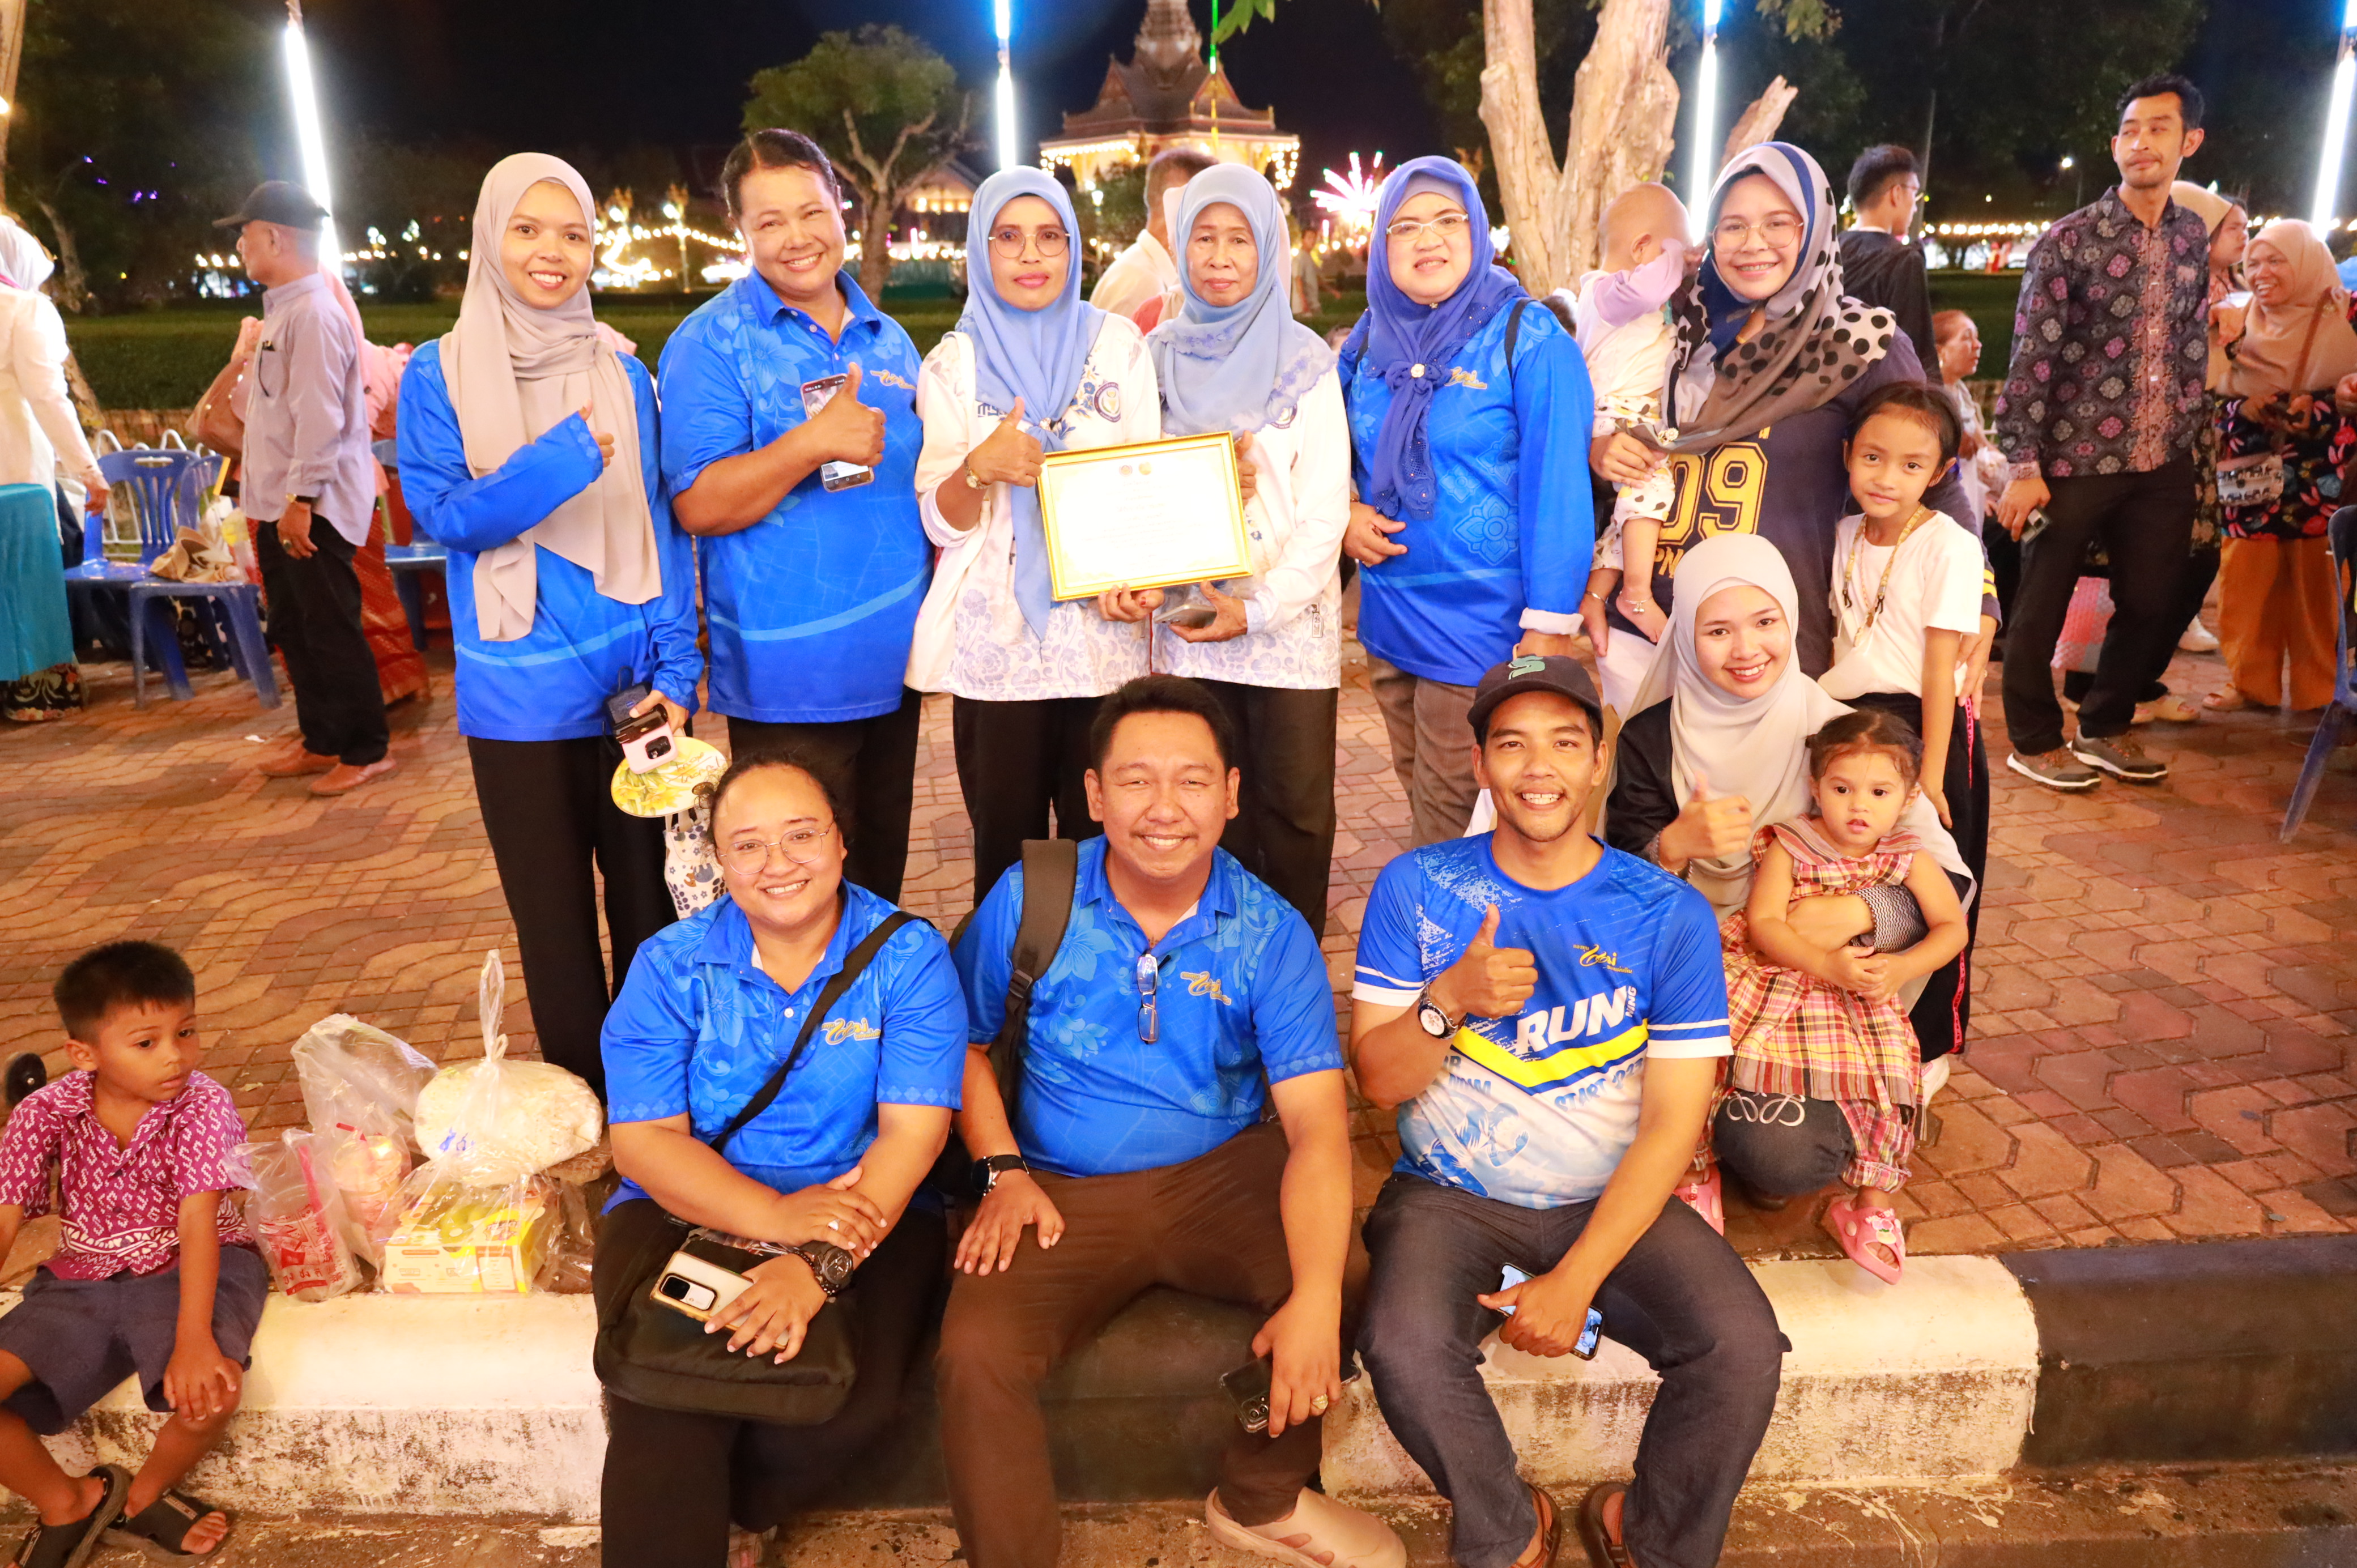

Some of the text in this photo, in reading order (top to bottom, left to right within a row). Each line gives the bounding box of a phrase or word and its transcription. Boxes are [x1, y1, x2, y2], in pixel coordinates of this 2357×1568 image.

[1516, 985, 1627, 1053] RUN
[1625, 986, 1637, 1018] NING
[1554, 1078, 1607, 1112] START
